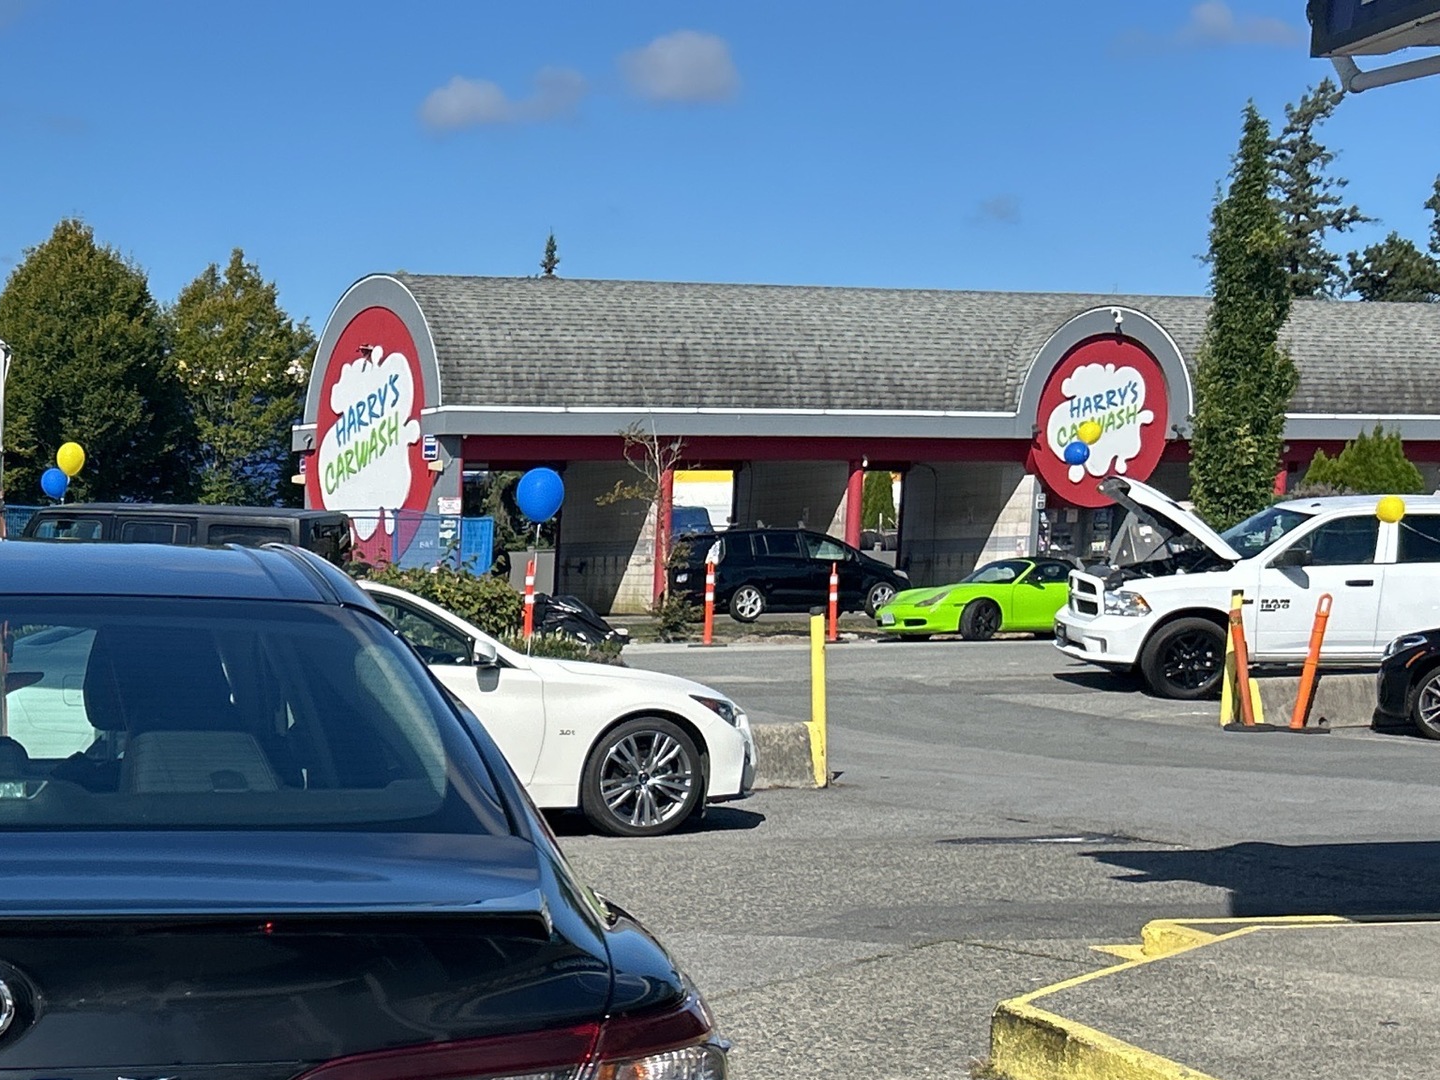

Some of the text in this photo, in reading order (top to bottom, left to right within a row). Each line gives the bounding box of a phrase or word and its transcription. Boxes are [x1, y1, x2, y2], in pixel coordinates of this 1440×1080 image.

[336, 374, 400, 446] HARRY'S
[1057, 404, 1138, 447] CAASH
[1069, 380, 1138, 418] HARRY'S
[325, 411, 399, 494] CARWASH
